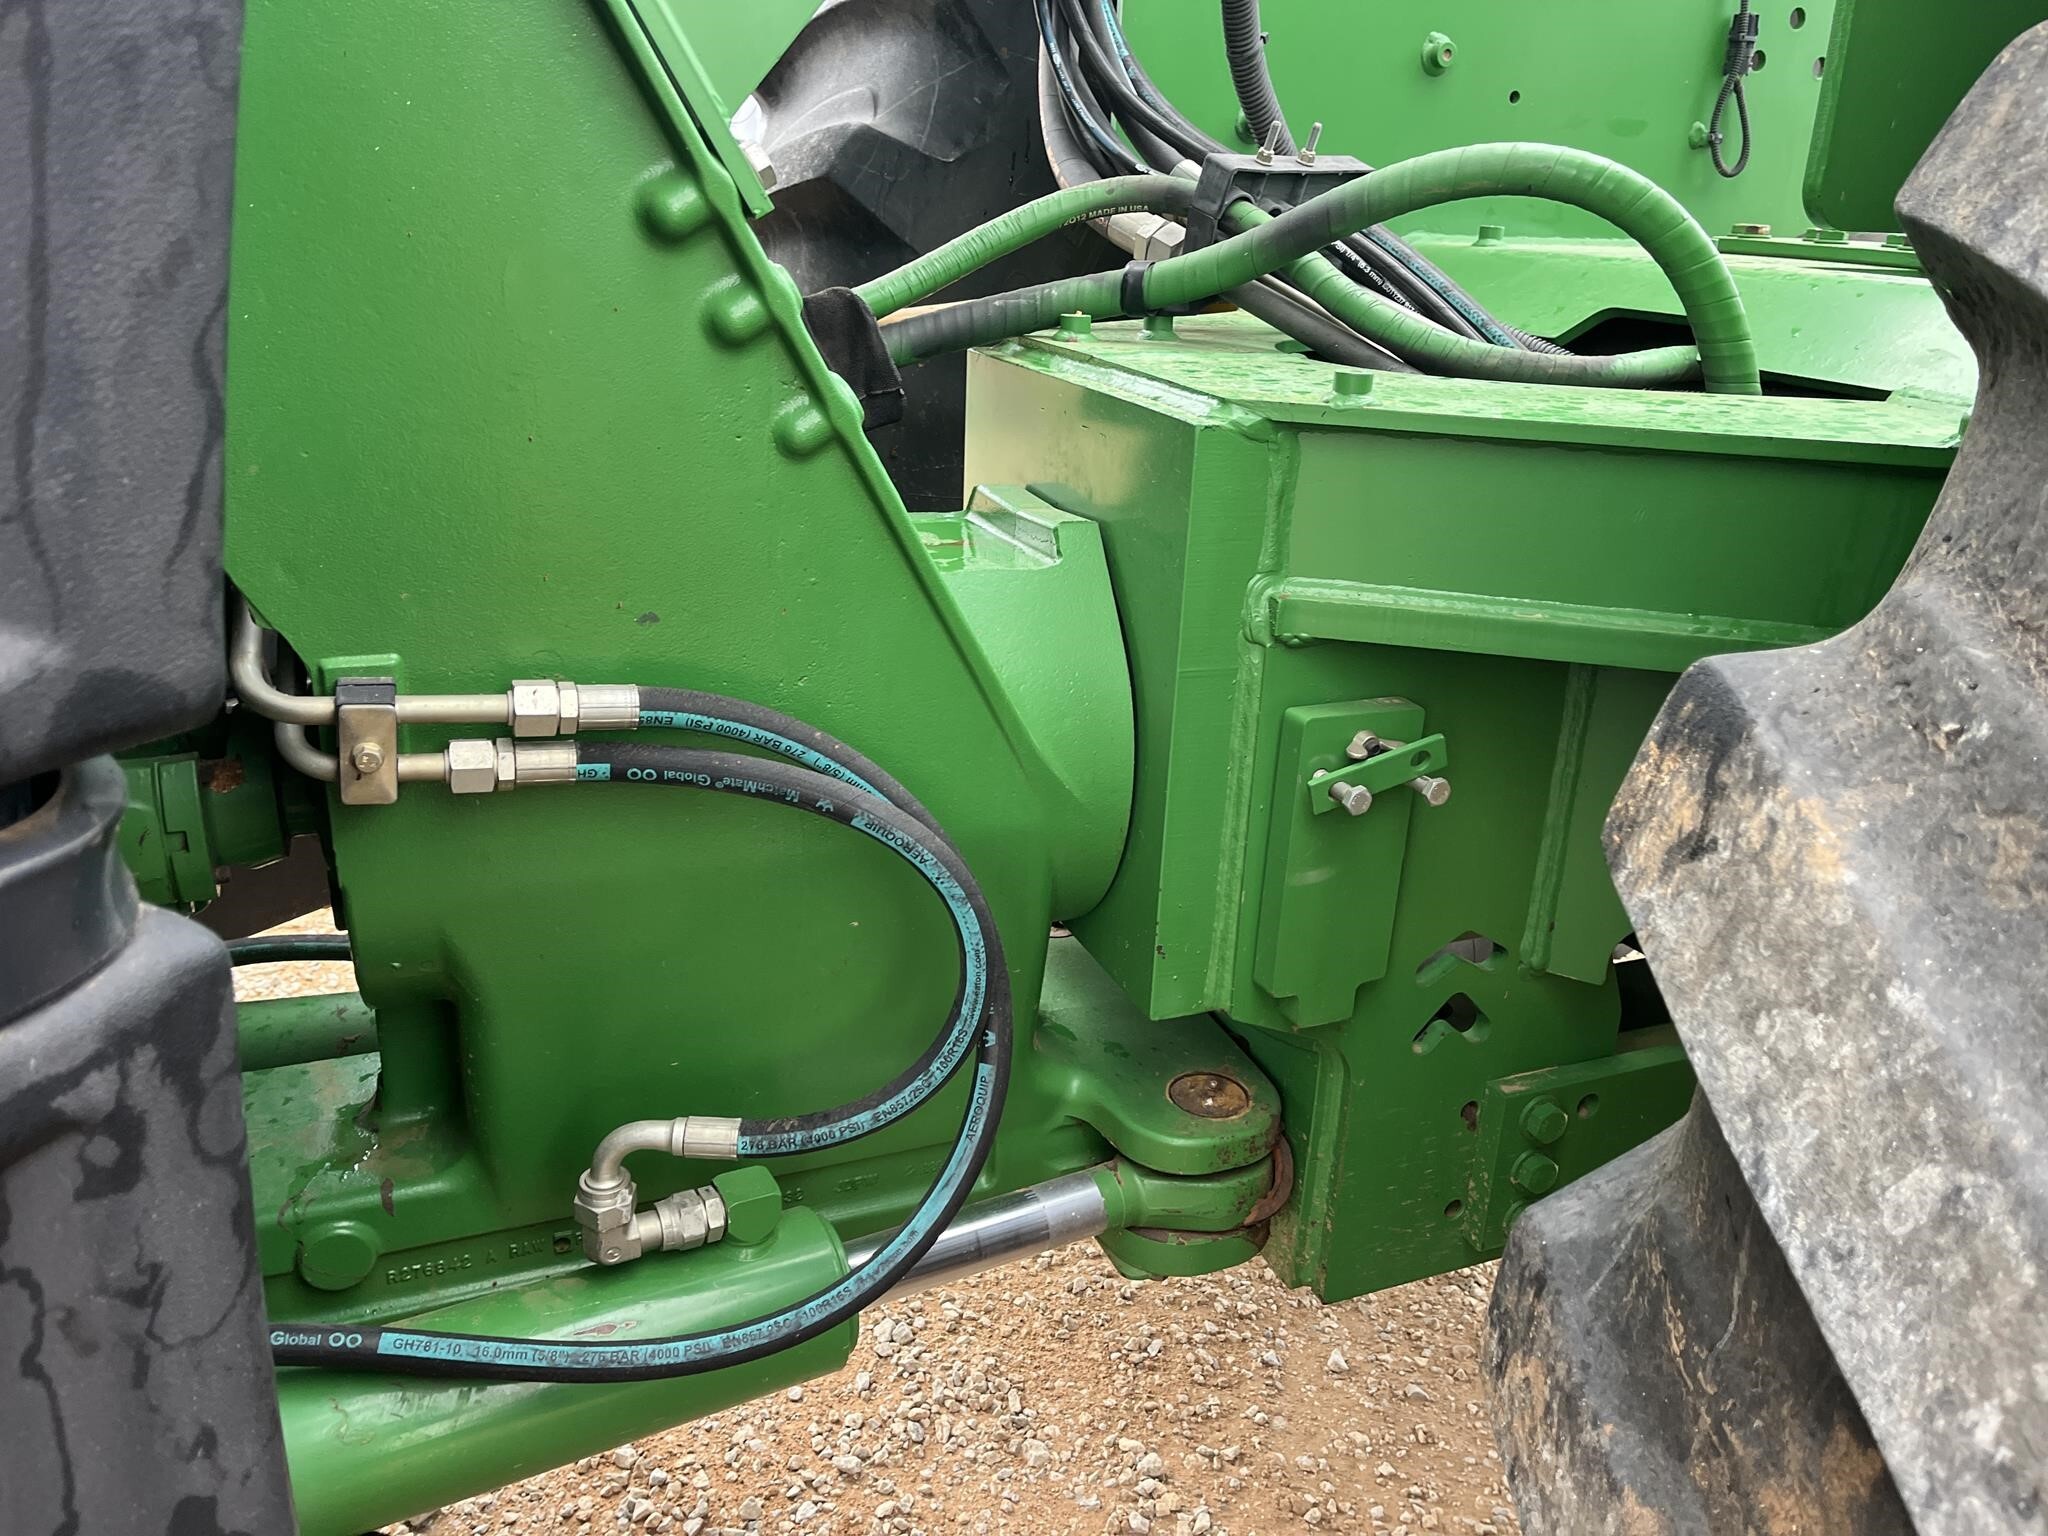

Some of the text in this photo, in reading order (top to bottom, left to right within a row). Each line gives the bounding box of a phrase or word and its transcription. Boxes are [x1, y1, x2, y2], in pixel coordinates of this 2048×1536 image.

[1088, 207, 1116, 218] MADE
[1117, 205, 1128, 213] IN
[1129, 204, 1149, 212] USA
[685, 717, 714, 731] PSI)
[716, 724, 752, 739] (4000
[753, 733, 783, 750] BAR
[784, 743, 807, 759] 276
[664, 770, 711, 786] Global
[863, 820, 931, 865] AEROQUIP
[966, 1074, 990, 1142] AEROQUIP
[769, 1137, 798, 1151] BAR
[270, 1331, 322, 1346] Global
[392, 1338, 462, 1355] GH781-10
[608, 1350, 640, 1363] BAR
